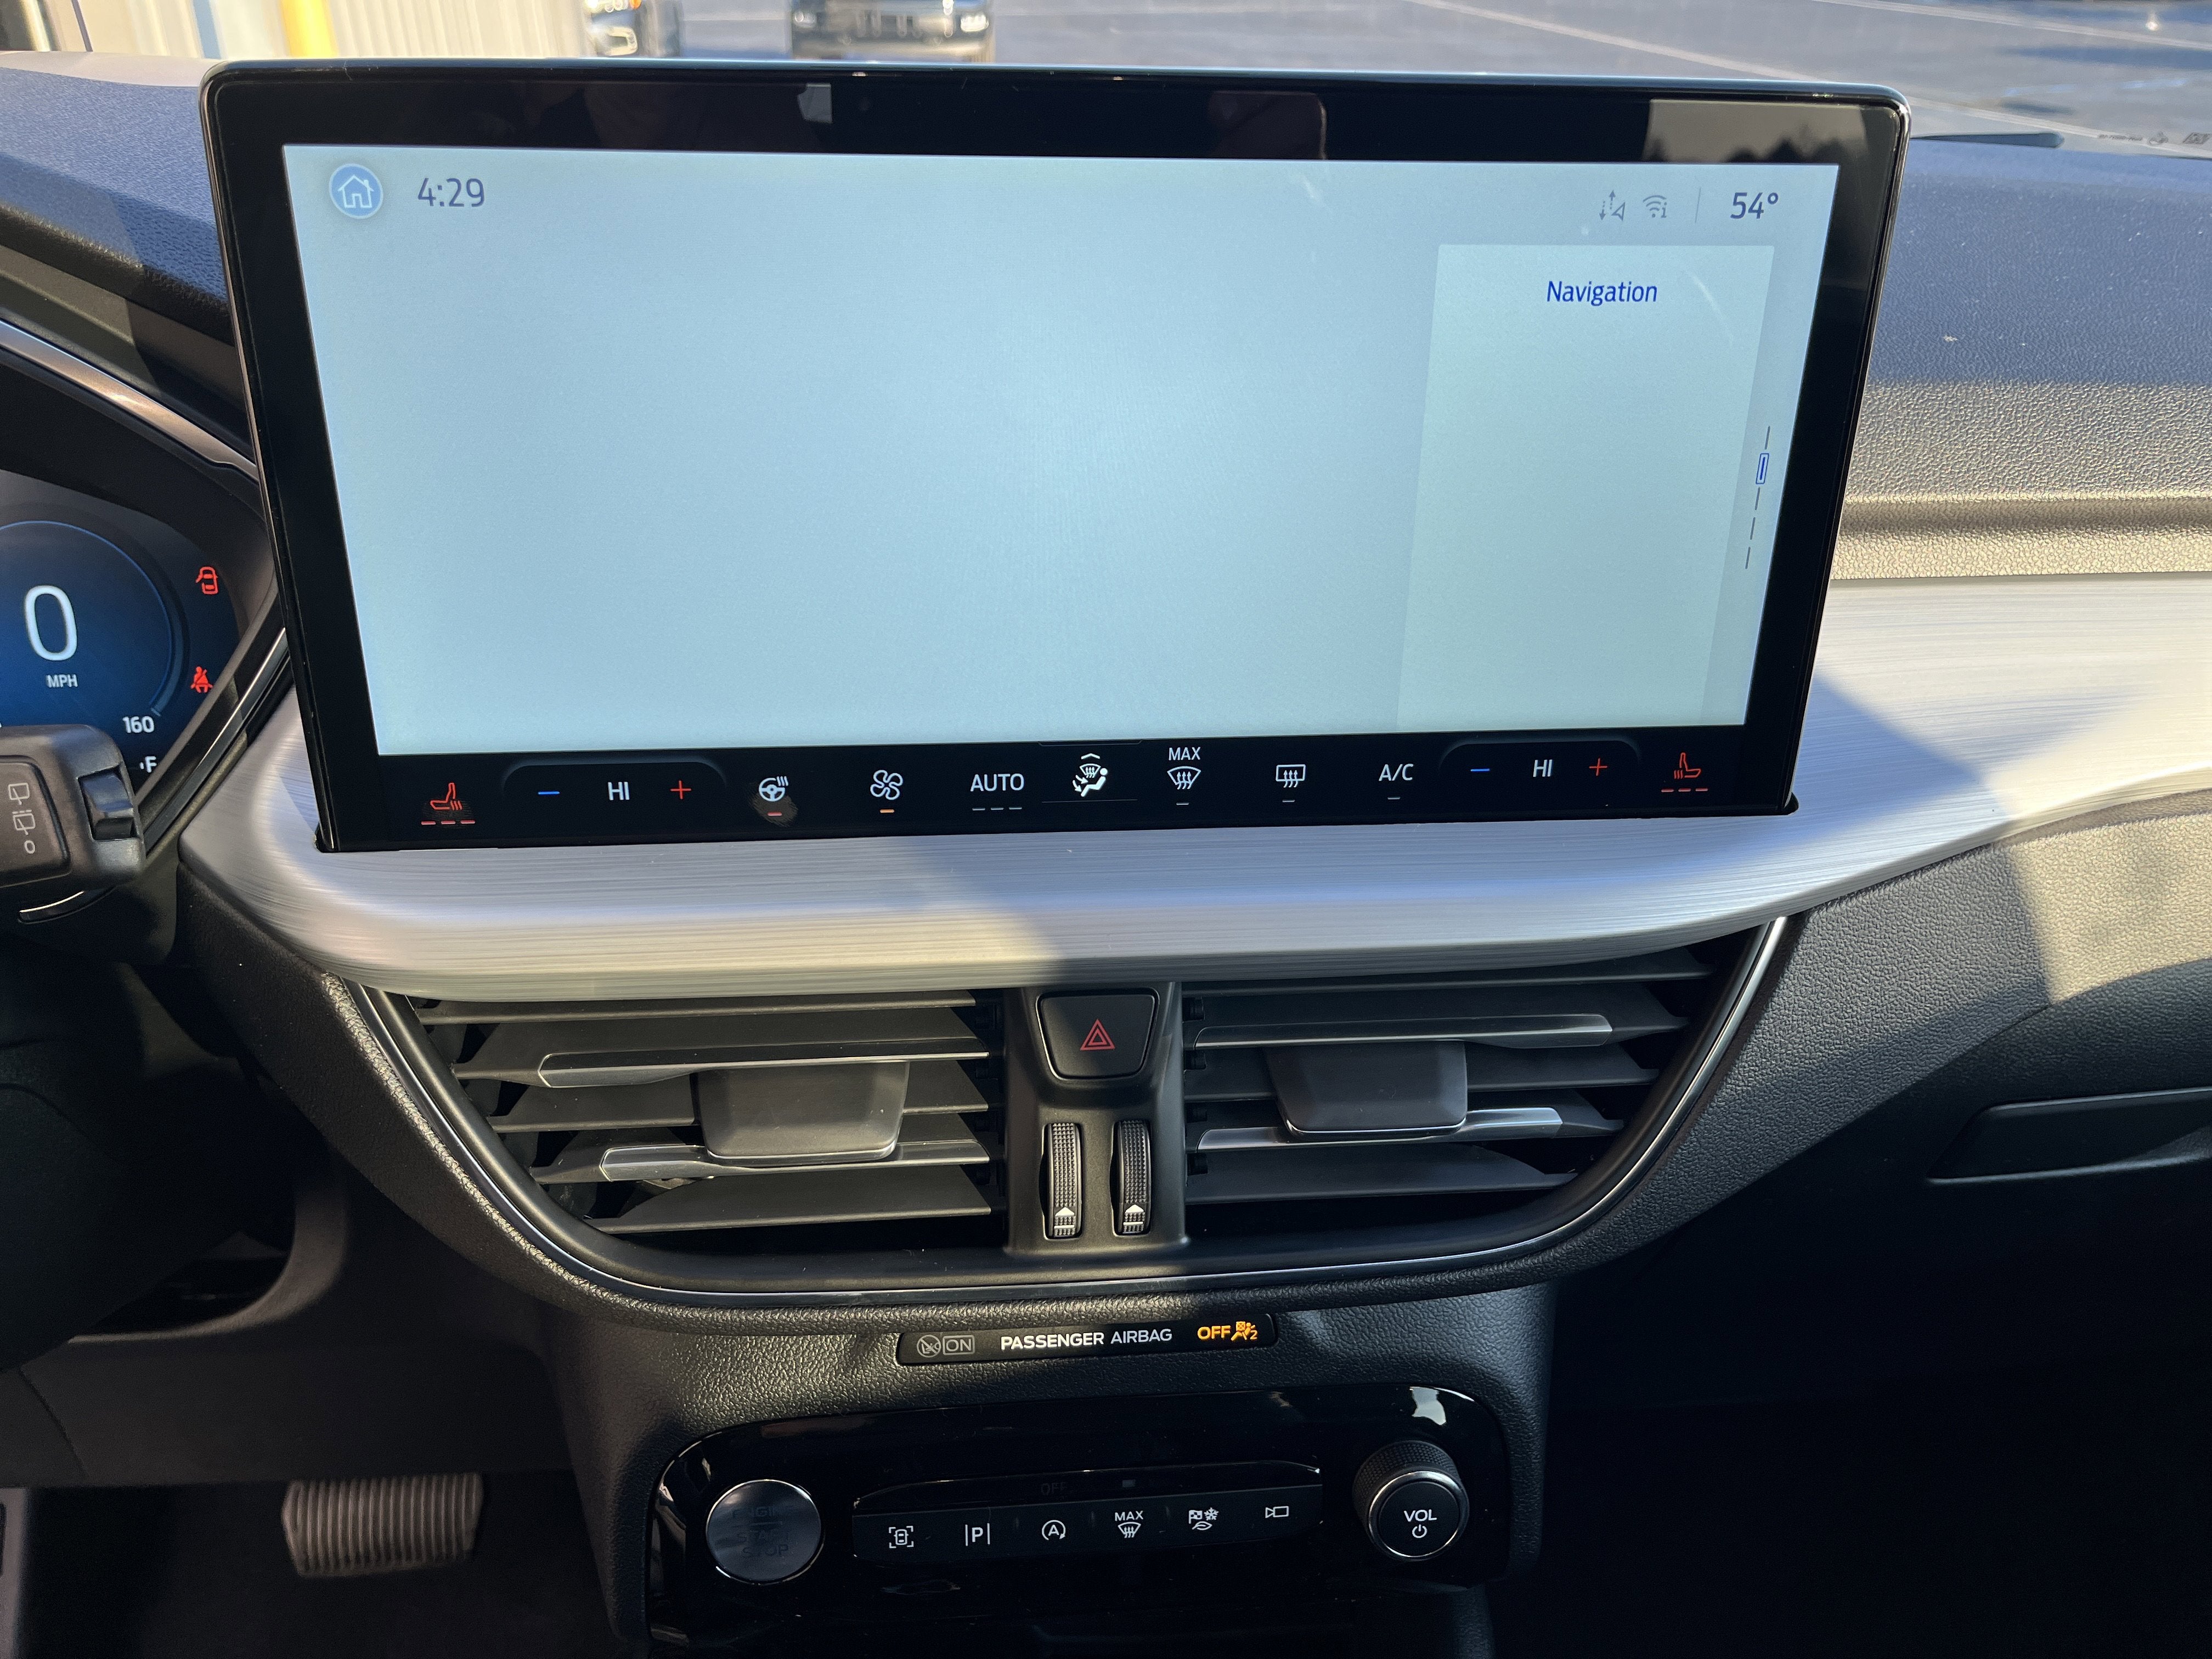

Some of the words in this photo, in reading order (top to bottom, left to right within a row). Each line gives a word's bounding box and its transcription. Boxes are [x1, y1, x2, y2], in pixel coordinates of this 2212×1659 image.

[417, 178, 484, 207] 4:29
[1547, 280, 1657, 307] Navigation
[25, 585, 77, 661] 0
[47, 674, 78, 688] MPH
[122, 715, 155, 733] 160
[1168, 747, 1201, 761] MAX
[1378, 763, 1414, 781] A/C
[1533, 759, 1553, 777] HI
[608, 781, 630, 800] HI
[970, 773, 1024, 792] AUTO
[946, 1337, 972, 1351] ON
[1001, 1332, 1104, 1351] PASSENGER
[1110, 1328, 1172, 1344] AIRBAG
[1198, 1325, 1231, 1340] OFF
[1115, 1510, 1144, 1523] MAX
[1403, 1509, 1437, 1522] VOL
